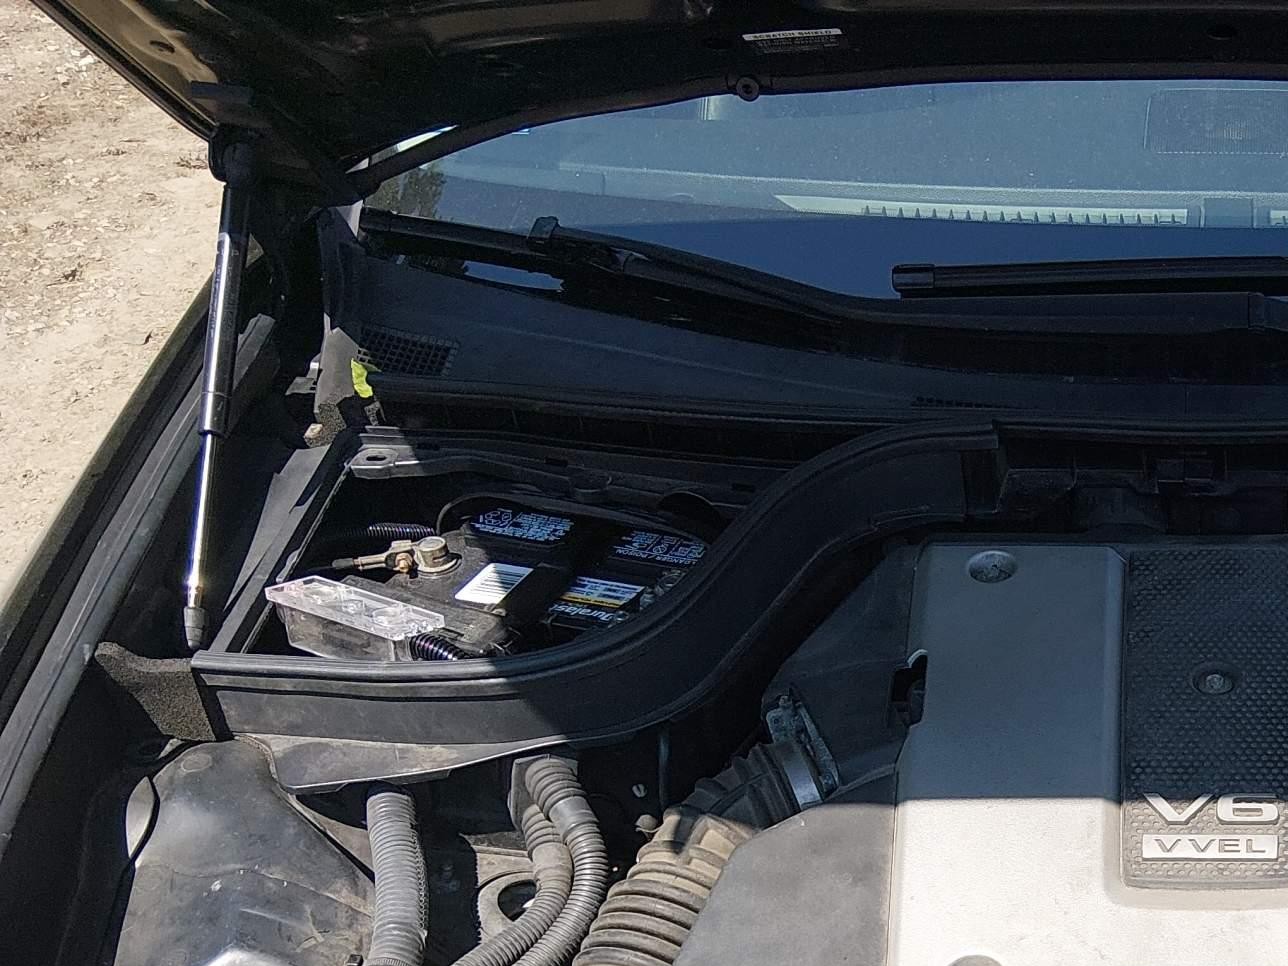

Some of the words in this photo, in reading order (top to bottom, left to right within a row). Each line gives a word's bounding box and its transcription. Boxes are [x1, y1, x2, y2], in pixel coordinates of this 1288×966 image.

[548, 604, 615, 621] Duralast
[1143, 792, 1280, 825] V6
[1153, 838, 1267, 854] VVEL
